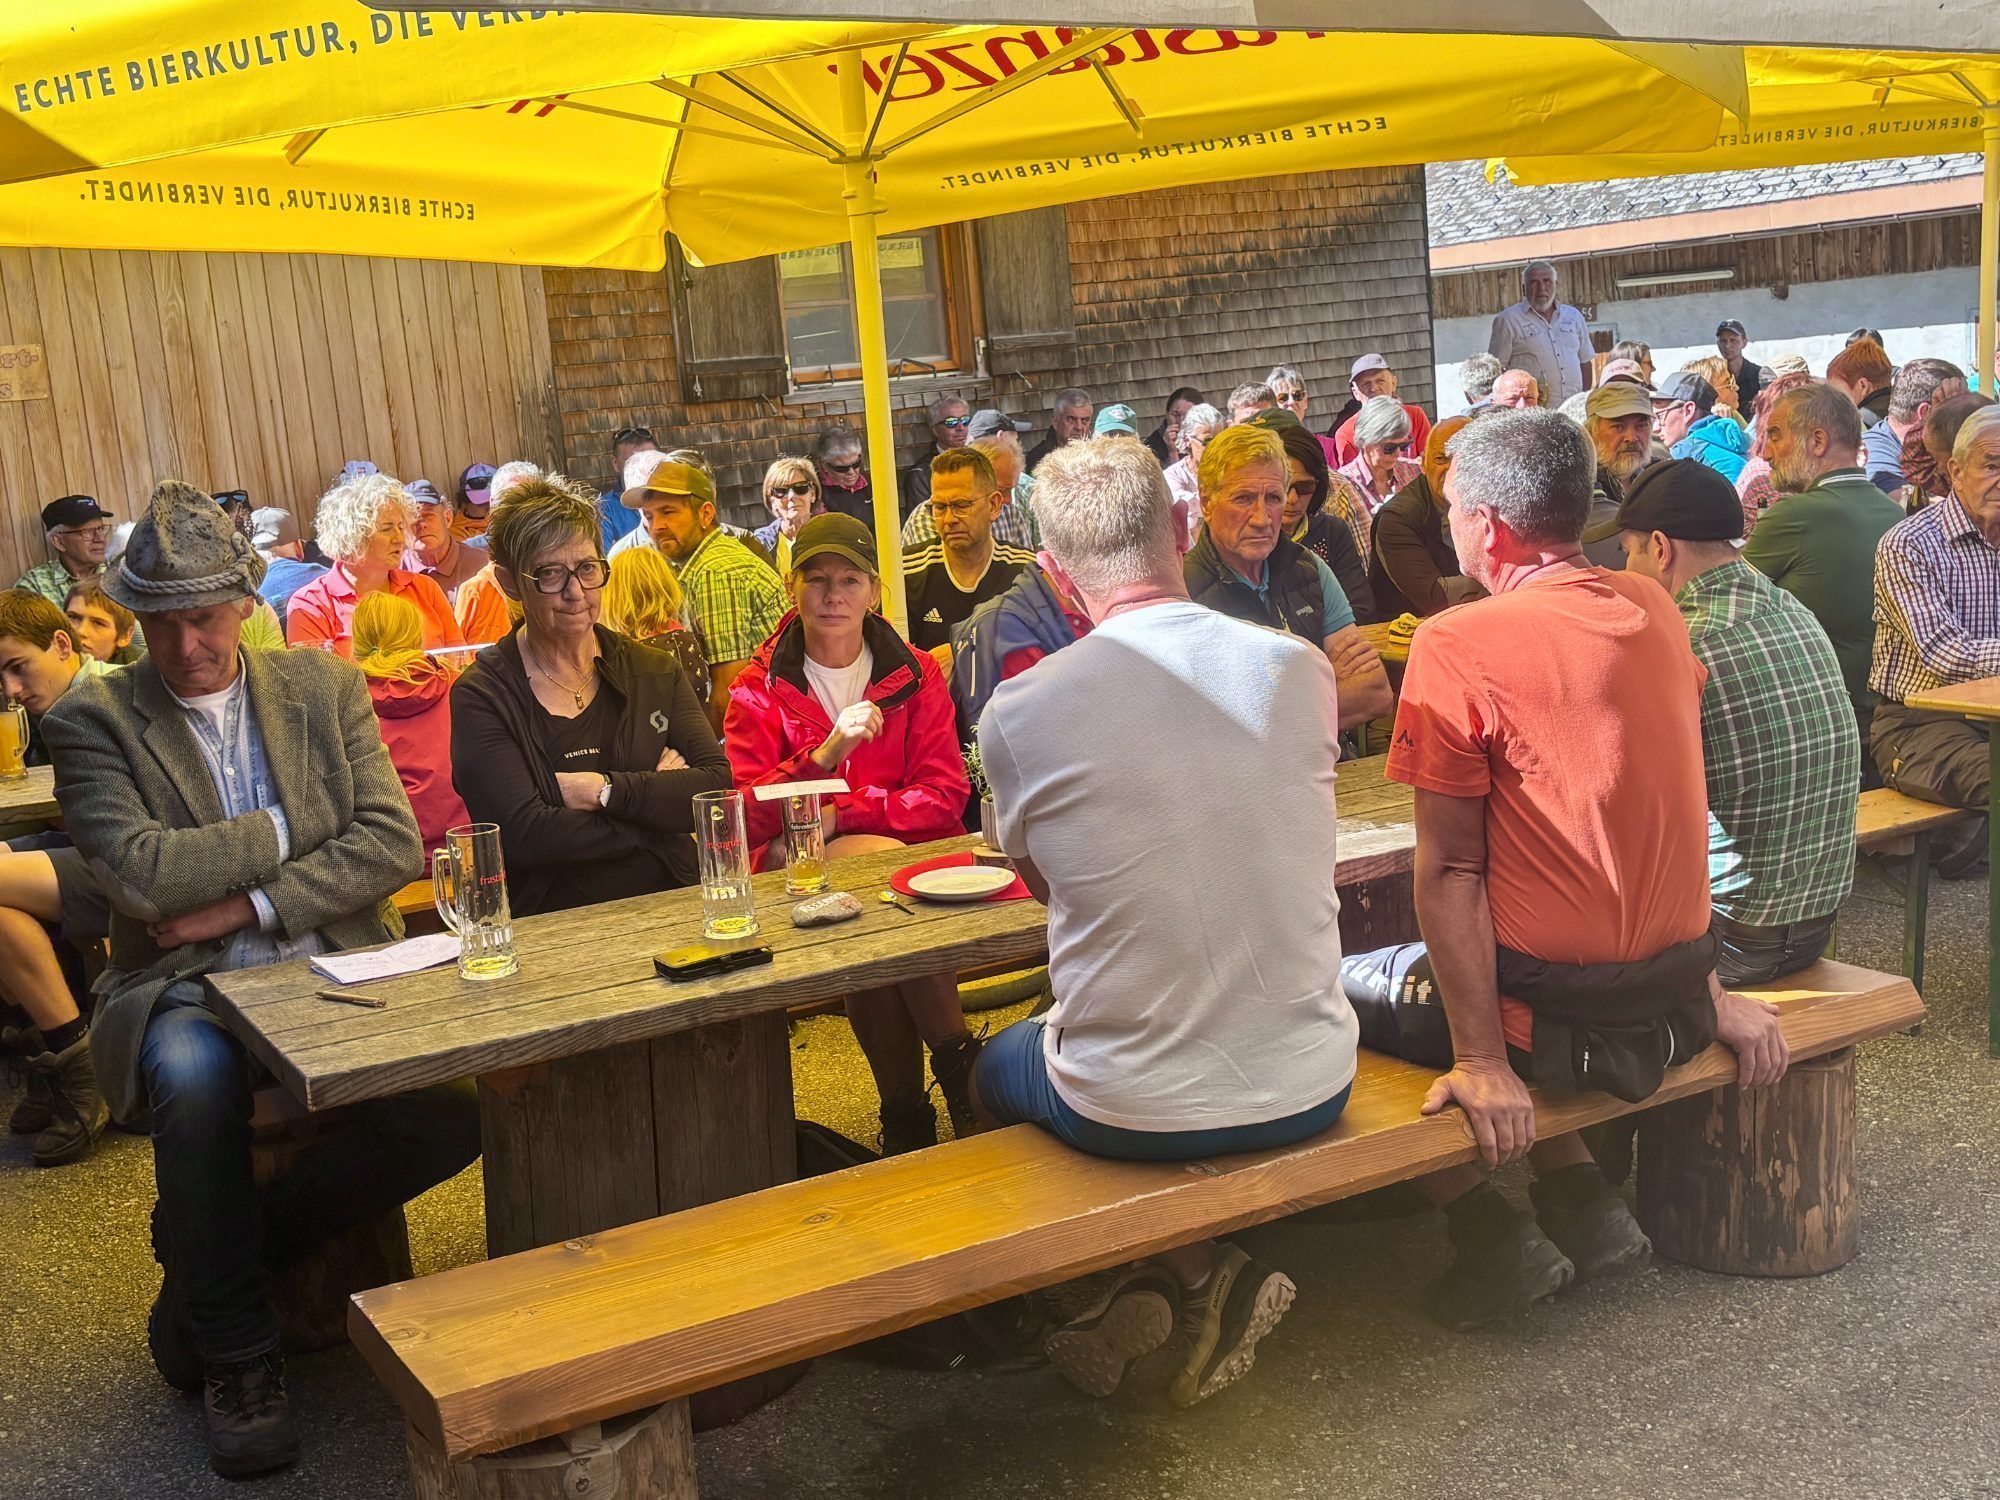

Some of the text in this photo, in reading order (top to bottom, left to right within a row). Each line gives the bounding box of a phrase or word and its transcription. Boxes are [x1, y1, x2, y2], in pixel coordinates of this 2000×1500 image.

[14, 66, 116, 112] ECHTE
[126, 21, 359, 91] BIERKULTUR,
[370, 11, 433, 44] DIE
[564, 748, 588, 759] VENICE
